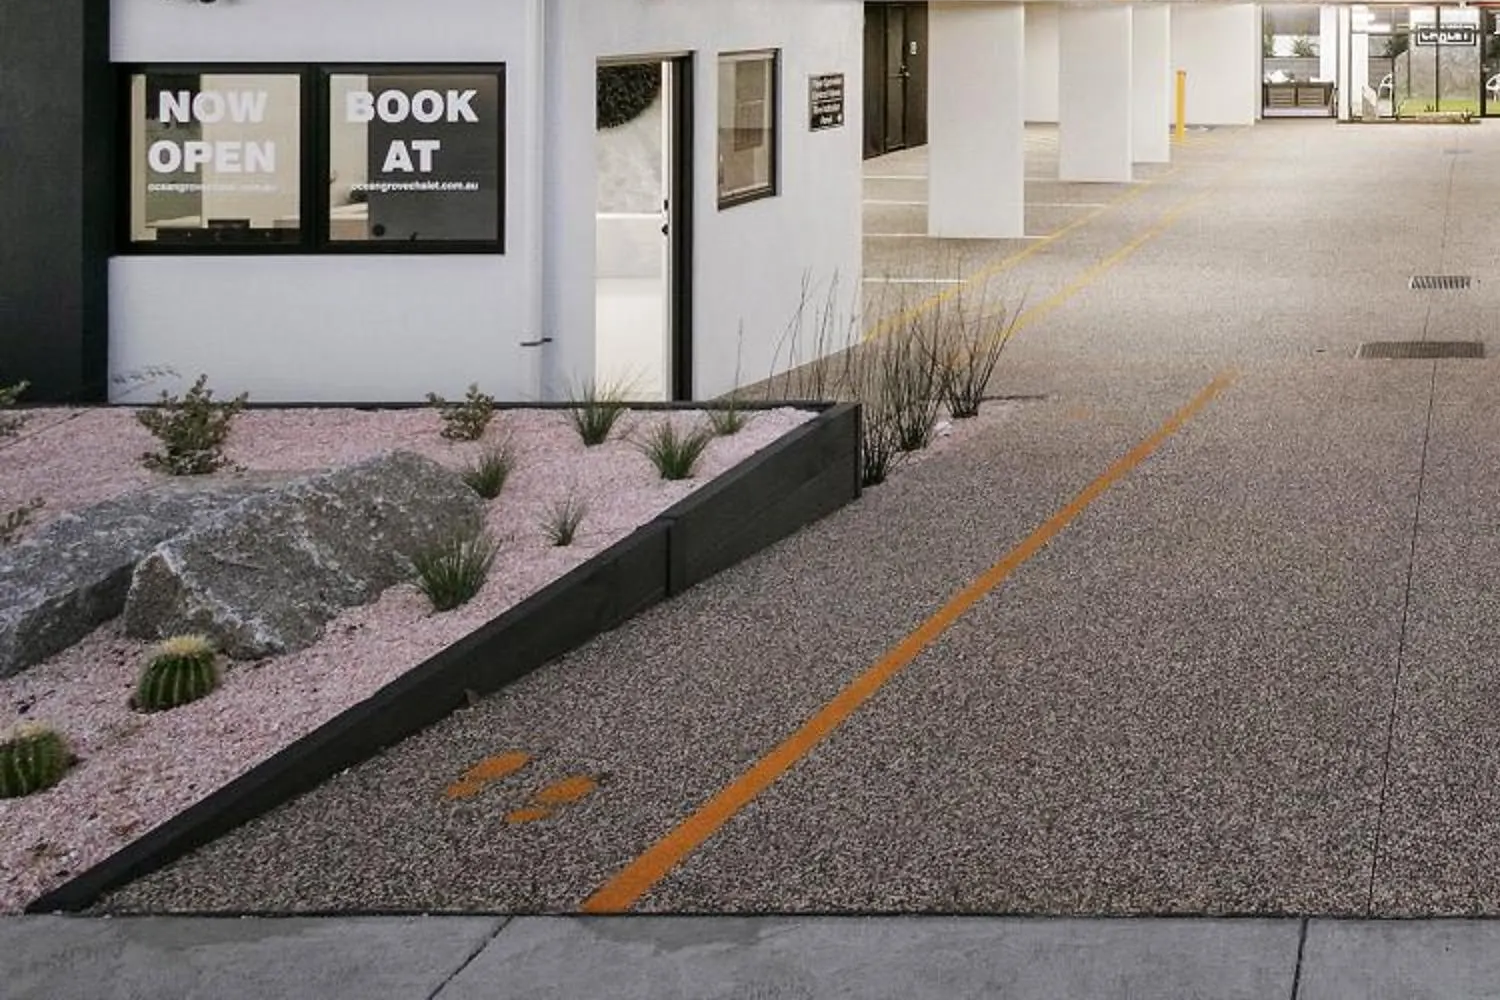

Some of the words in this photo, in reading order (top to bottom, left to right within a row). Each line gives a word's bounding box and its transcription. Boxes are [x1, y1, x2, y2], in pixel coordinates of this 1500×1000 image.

[159, 90, 268, 123] NOW
[346, 89, 479, 123] BOOK
[148, 140, 276, 173] OPEN
[381, 139, 441, 173] AT
[351, 181, 480, 193] oceangrovechalet.com.au
